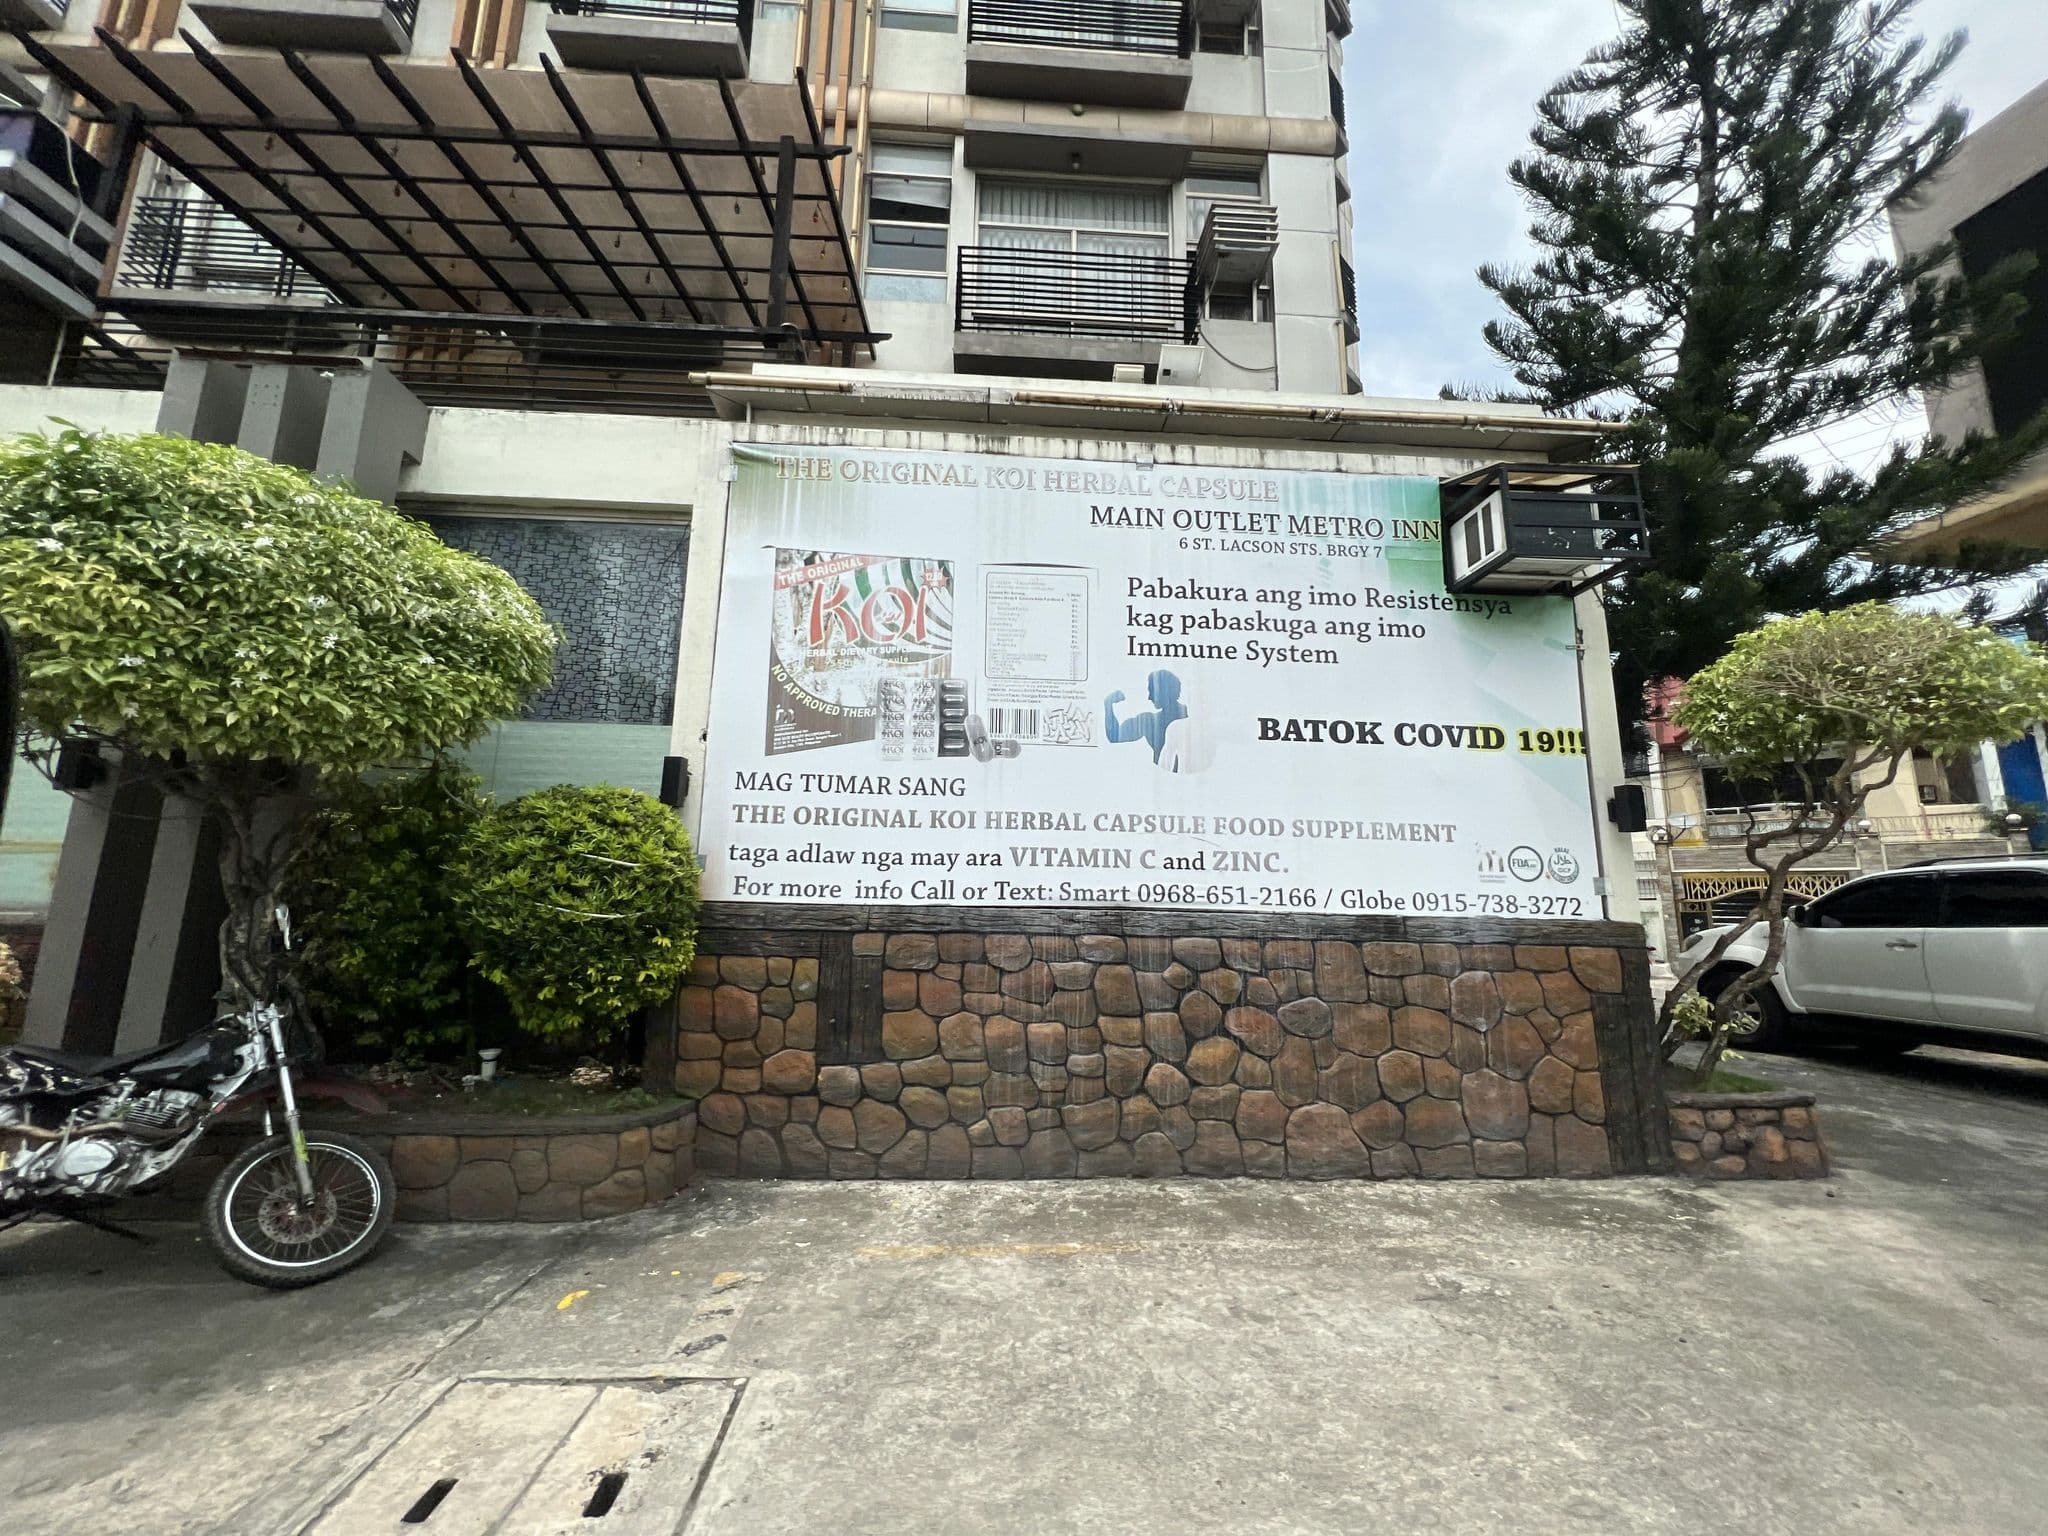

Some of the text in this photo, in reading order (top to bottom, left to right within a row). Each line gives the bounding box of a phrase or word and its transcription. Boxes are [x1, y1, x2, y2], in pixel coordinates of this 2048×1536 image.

[774, 456, 1278, 501] THE ORIGINAL KOI HERBAL CAPSULE
[1090, 506, 1440, 542] MAIN OUTLET METRO INN
[1179, 538, 1382, 558] 6 ST. LACSON STS. BRGY 7
[779, 558, 864, 585] THE ORIGINAL
[810, 582, 928, 647] KOI
[1127, 578, 1512, 619] Pabakura ang imo Resistensya
[1127, 606, 1426, 643] kag pabaskuga ang imo
[1127, 636, 1338, 668] Immune System
[772, 664, 786, 681] NO
[784, 683, 840, 715] APPROVED
[1258, 718, 1383, 745] BATOK
[1394, 722, 1505, 750] COVID
[735, 772, 966, 797] MAG TUMAR SANG
[733, 805, 1456, 842] THE ORIGINAL KOI HERBAL CAPSULE FOOD SUPPLEMENT
[729, 843, 1289, 873] taga adlaw nga may ara VITAMIN C and ZINC.
[734, 876, 1583, 916] For more info Call or Text: Smart 0968-651-2166 / Globe 0915-738-3272
